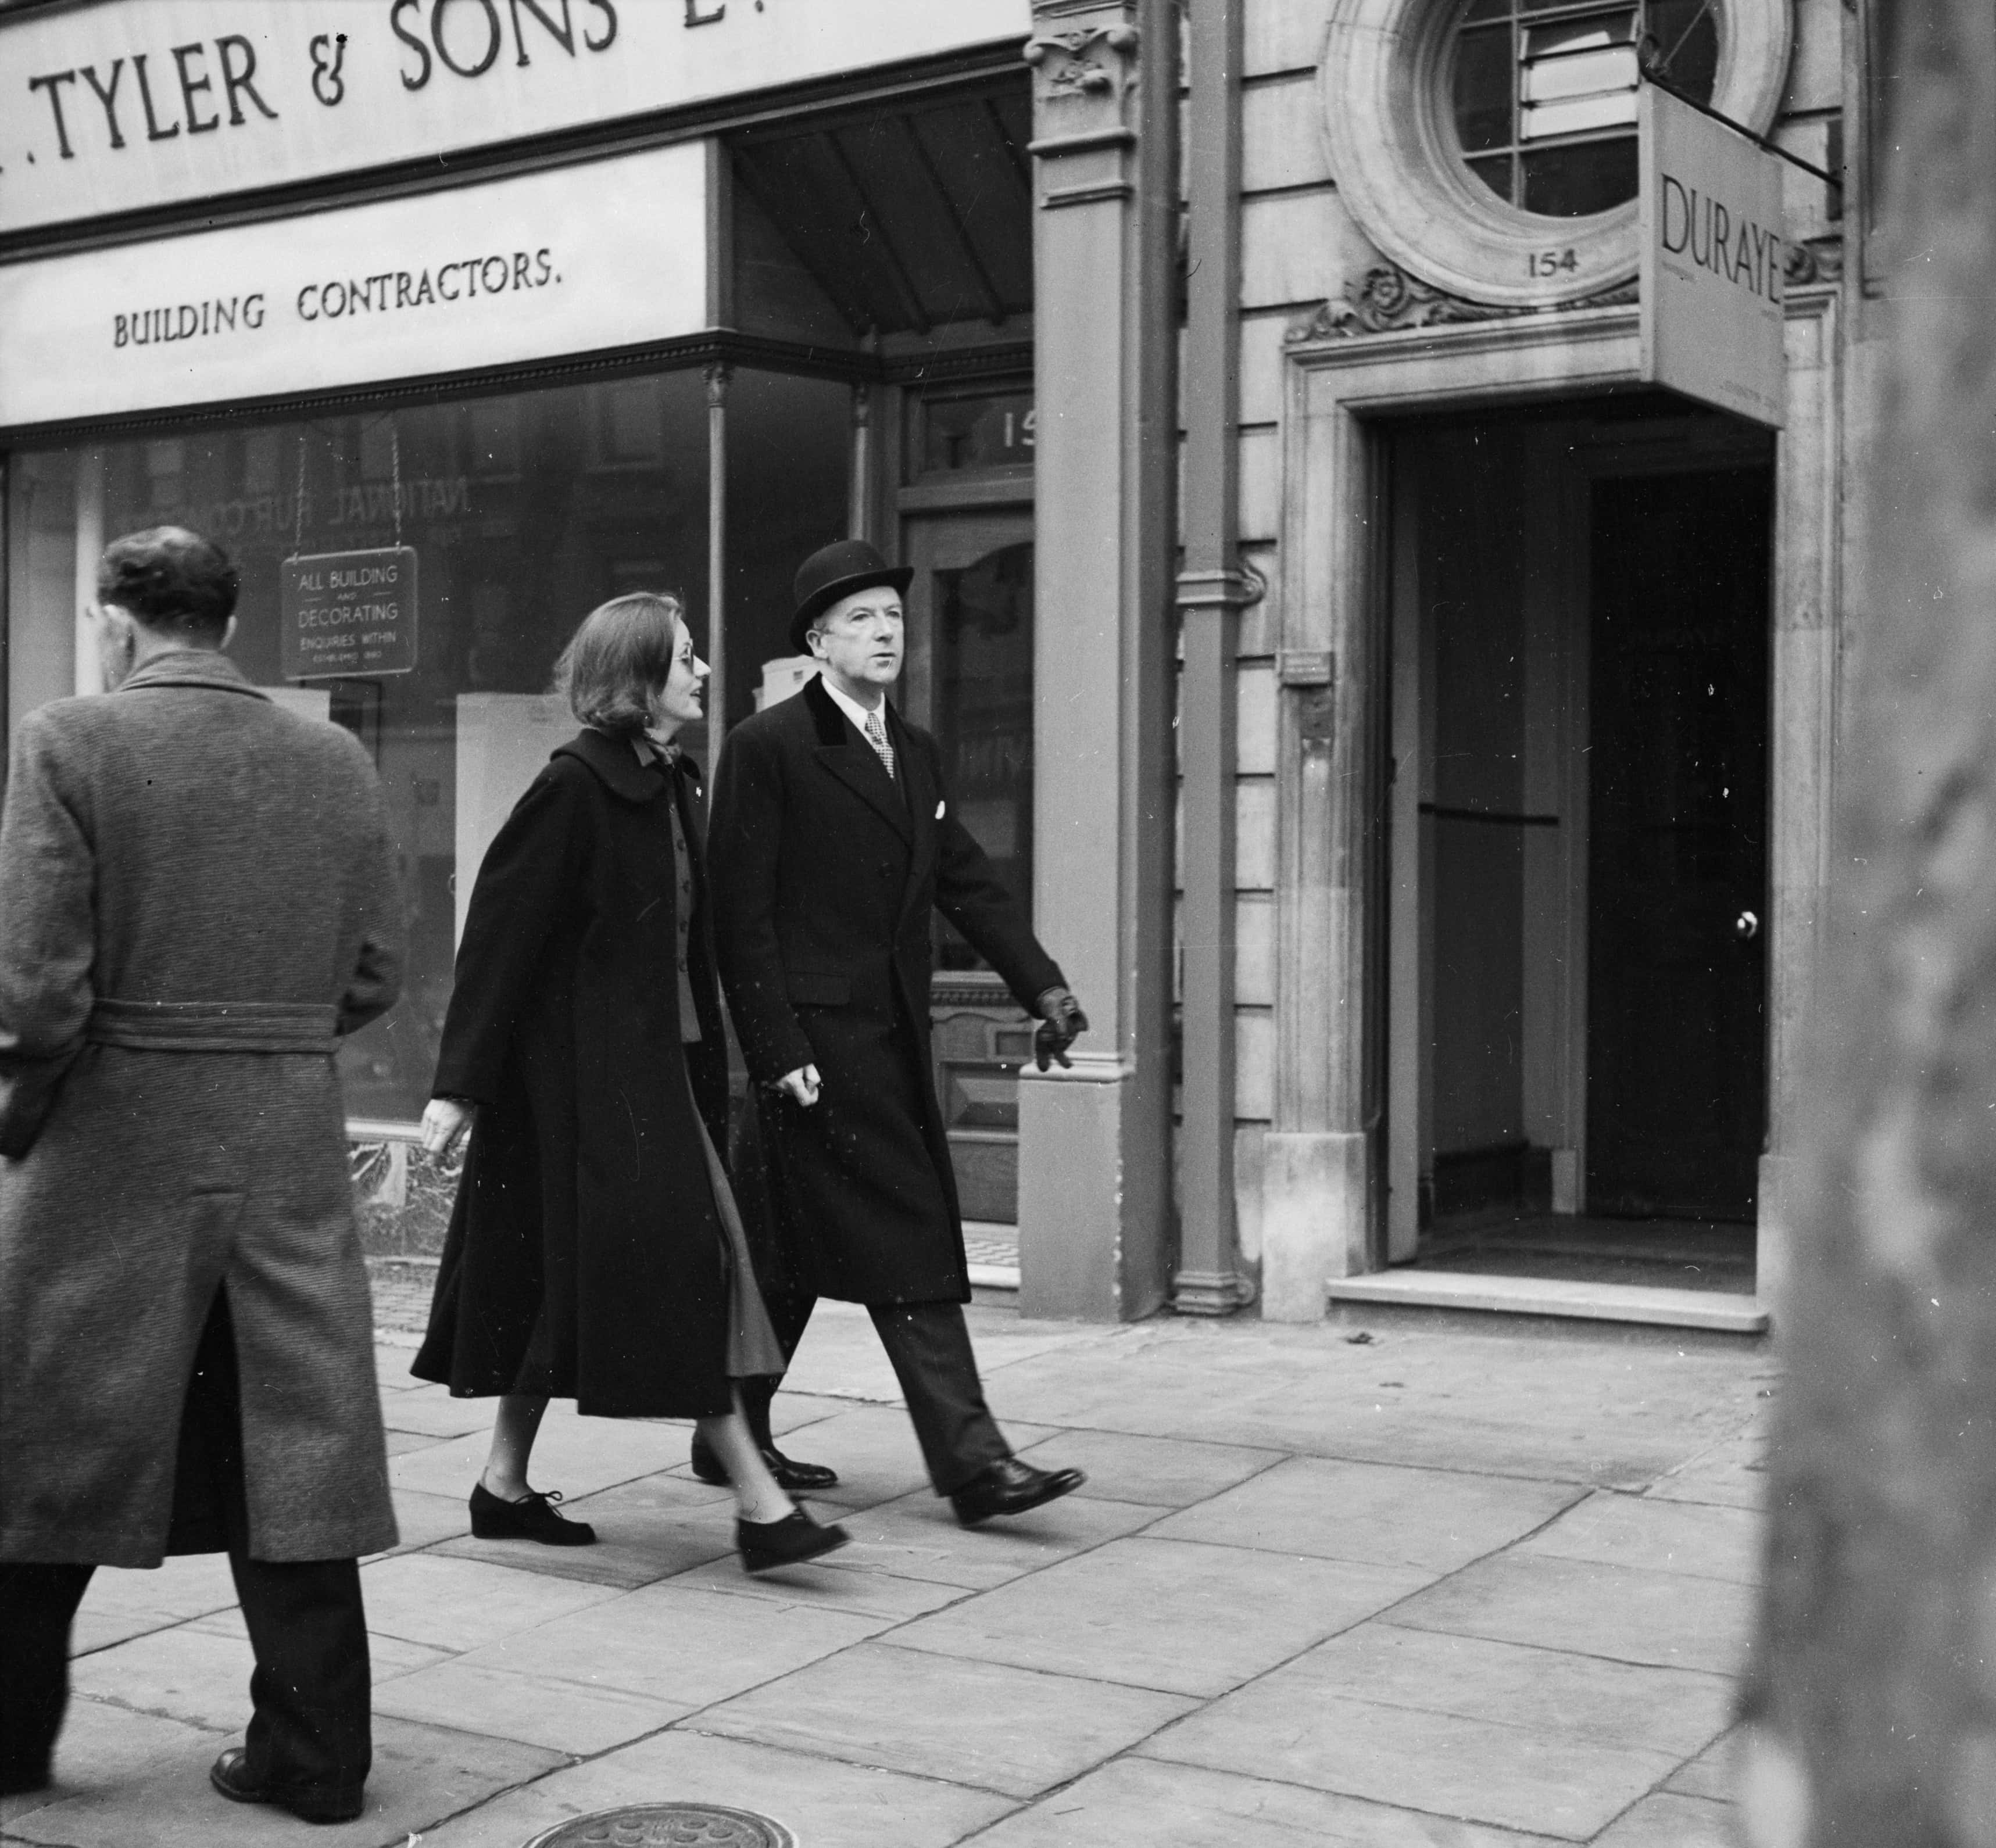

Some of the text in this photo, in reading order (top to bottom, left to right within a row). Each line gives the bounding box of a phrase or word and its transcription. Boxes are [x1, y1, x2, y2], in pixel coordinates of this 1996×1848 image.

[28, 0, 617, 159] TYLER & SONS
[1529, 248, 1579, 278] 154
[1661, 173, 1781, 305] DURAYE
[113, 248, 562, 349] BUILDING CONTRACTORS.
[297, 565, 398, 592] ALL BUILDING
[298, 602, 399, 628] DECORATING
